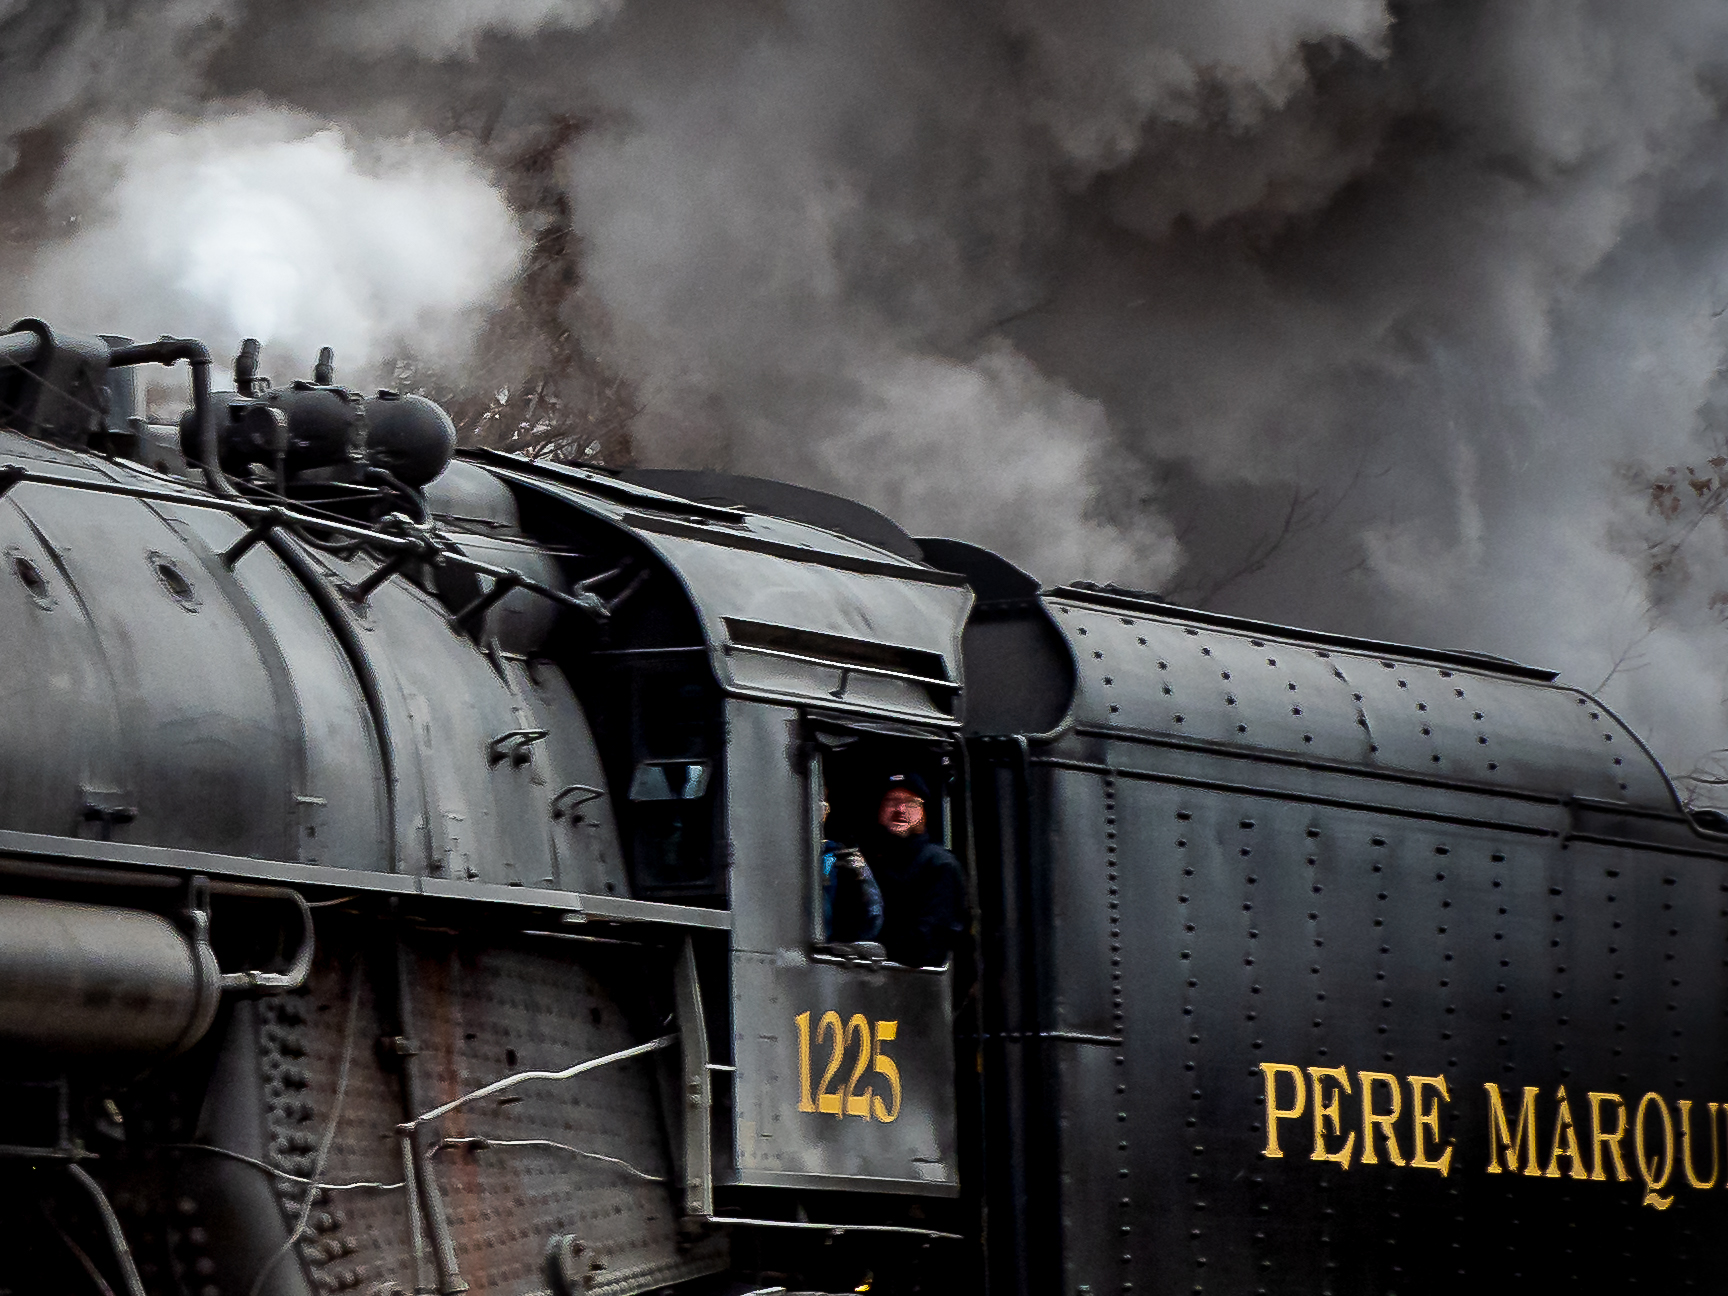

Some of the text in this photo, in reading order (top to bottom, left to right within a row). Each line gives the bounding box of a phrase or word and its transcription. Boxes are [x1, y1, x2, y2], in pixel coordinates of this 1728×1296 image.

[794, 1010, 903, 1124] 1225
[1258, 1062, 1728, 1210] PERE MARQU
